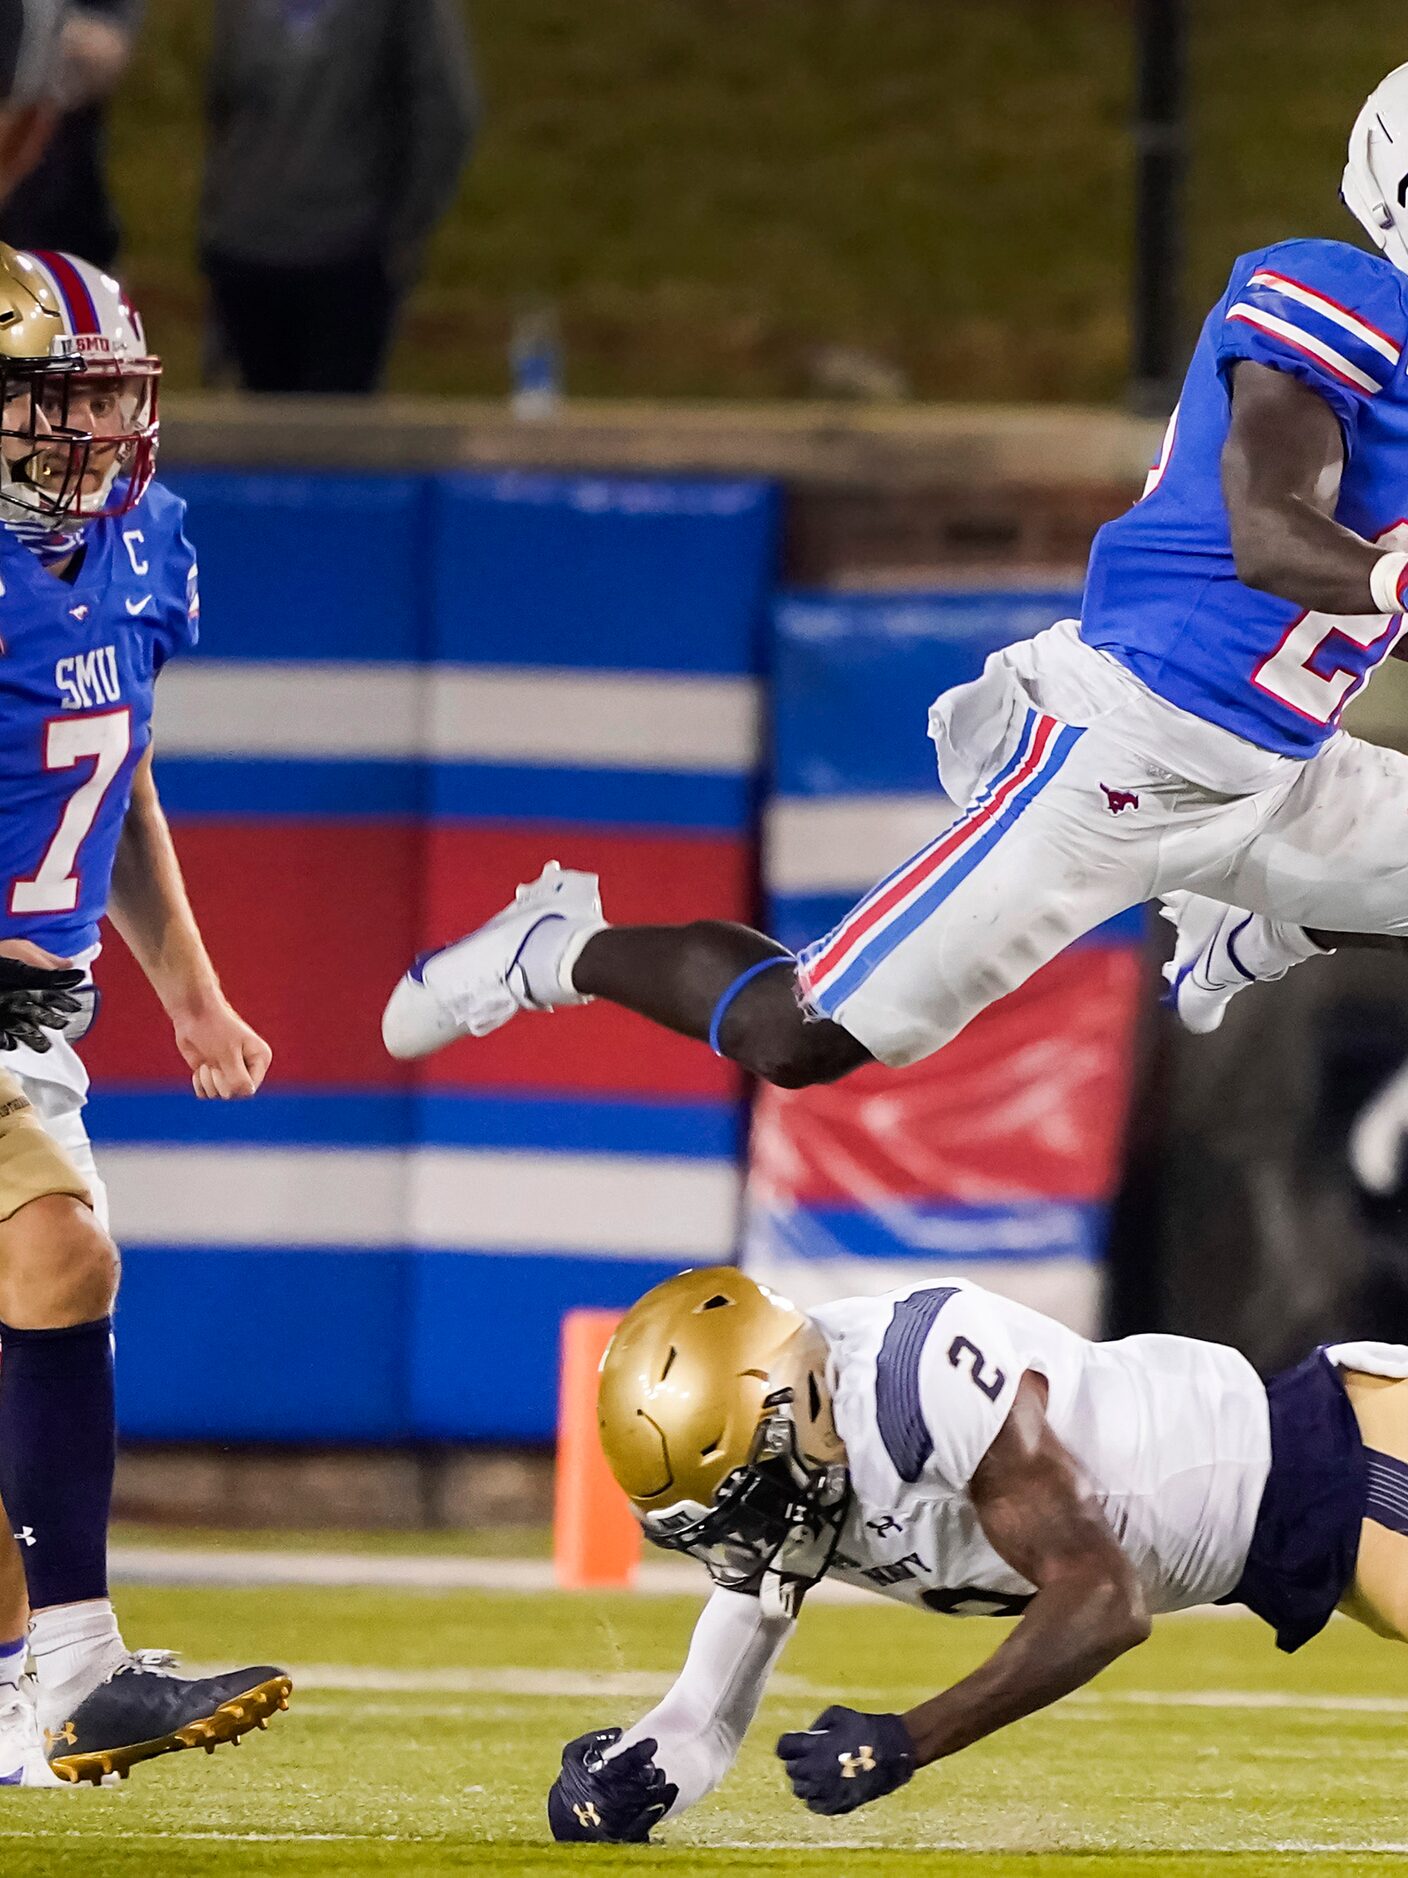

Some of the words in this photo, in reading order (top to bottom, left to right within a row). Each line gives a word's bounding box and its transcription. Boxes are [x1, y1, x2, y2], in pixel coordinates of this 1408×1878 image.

[123, 530, 149, 576] C
[56, 645, 121, 710] SMU
[8, 705, 133, 917] 7
[948, 1335, 1005, 1402] 2
